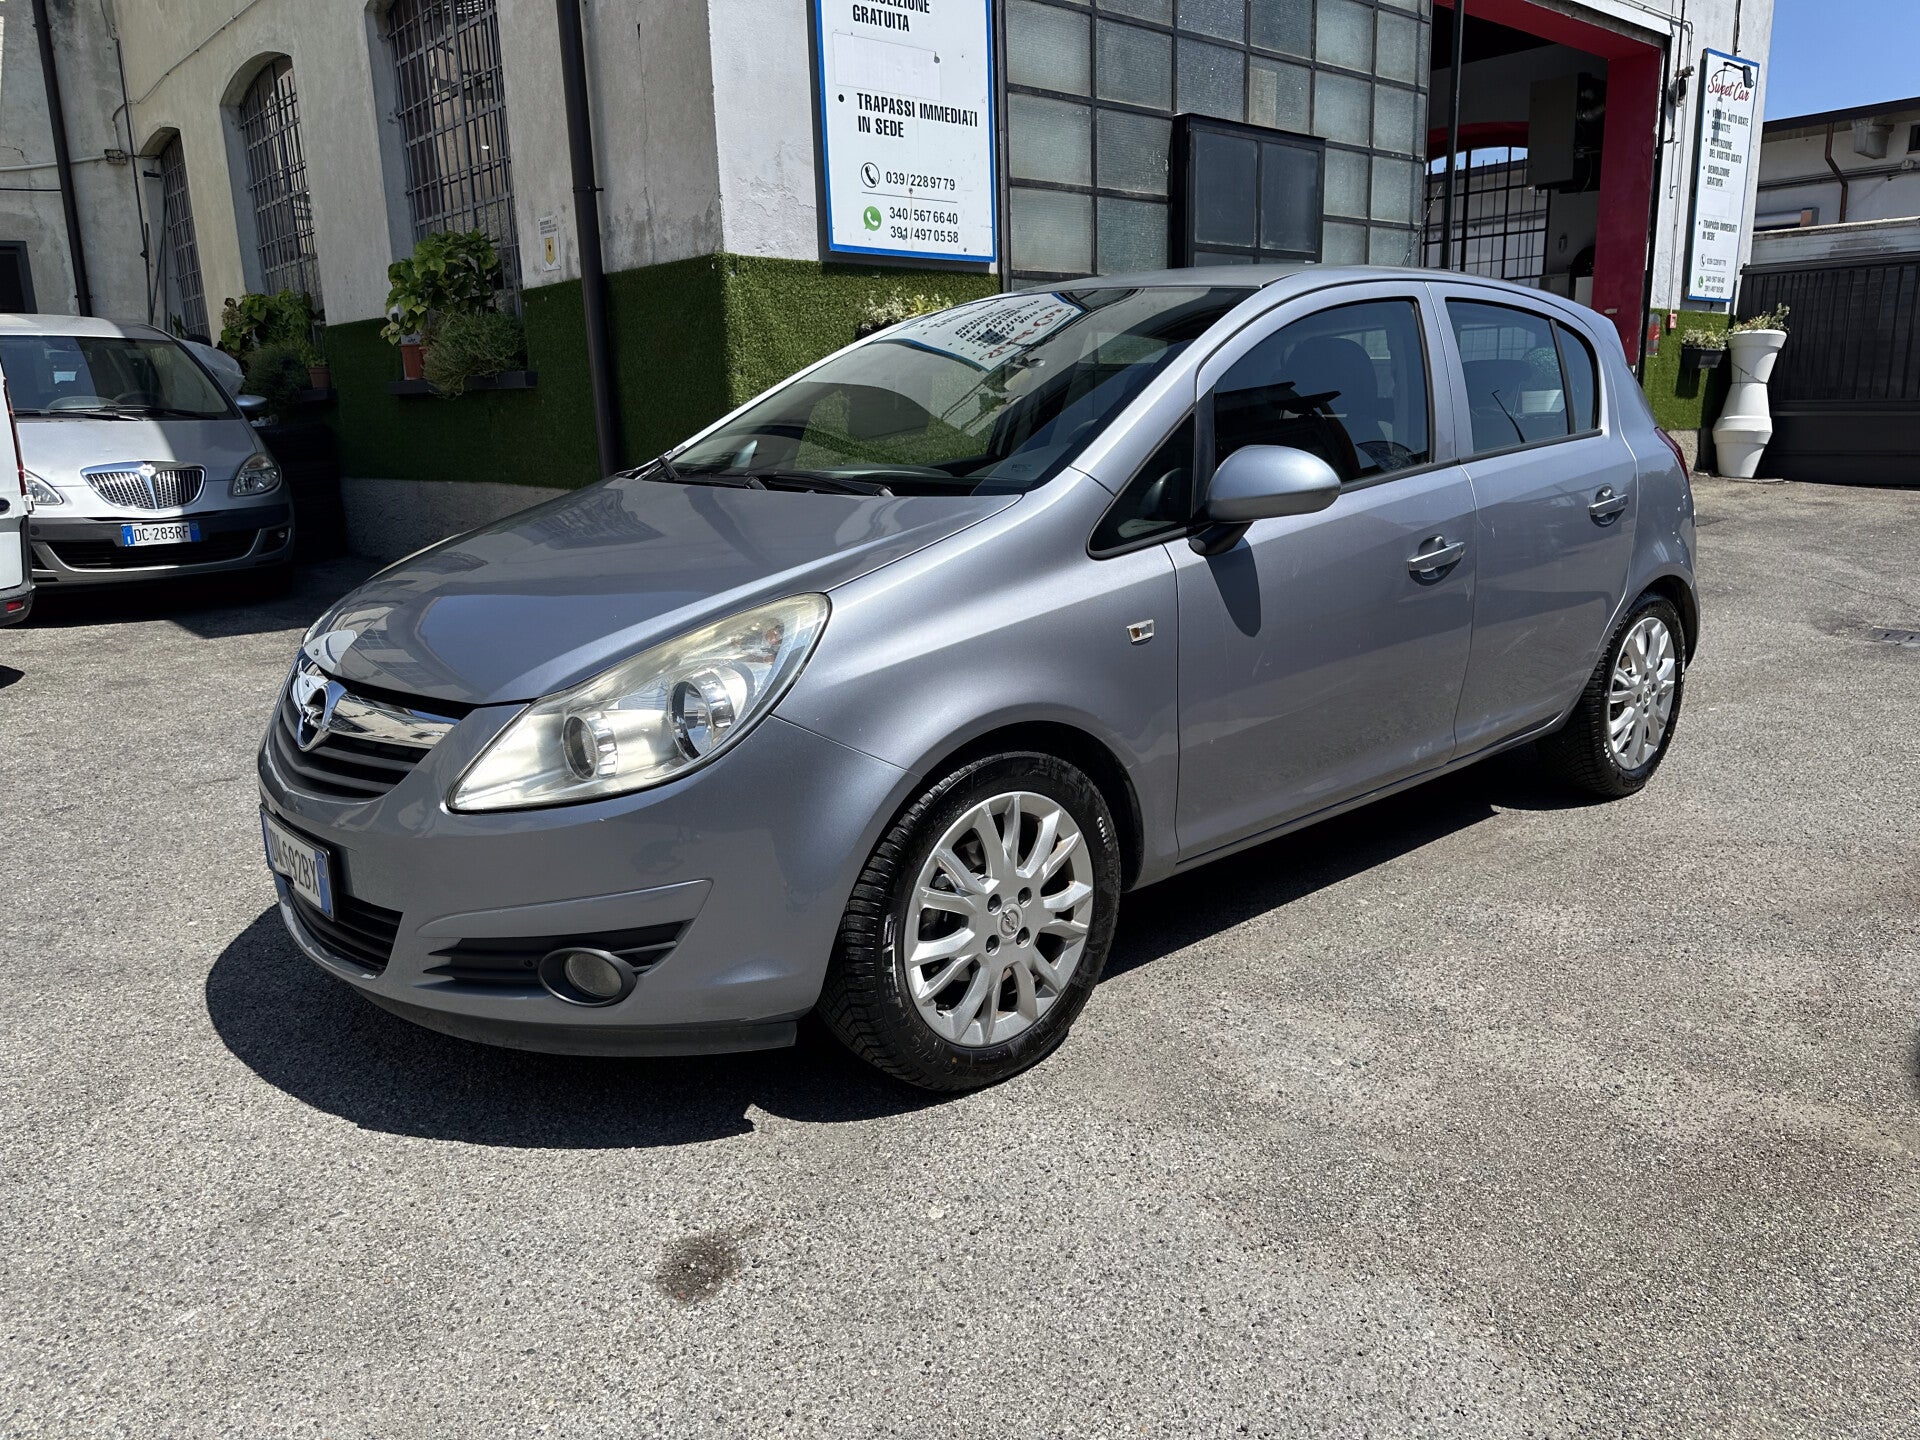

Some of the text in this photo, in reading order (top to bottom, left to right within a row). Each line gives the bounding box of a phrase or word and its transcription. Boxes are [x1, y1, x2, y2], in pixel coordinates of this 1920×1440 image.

[852, 4, 910, 32] GRATUITA
[1707, 72, 1750, 102] Sweet Car
[856, 92, 978, 128] TRAPASSI IMMEDIATI
[857, 115, 904, 138] IN SEDE
[886, 171, 956, 191] 039/2289779
[889, 206, 958, 225] 340/5676640
[890, 226, 959, 244] 391/4970558
